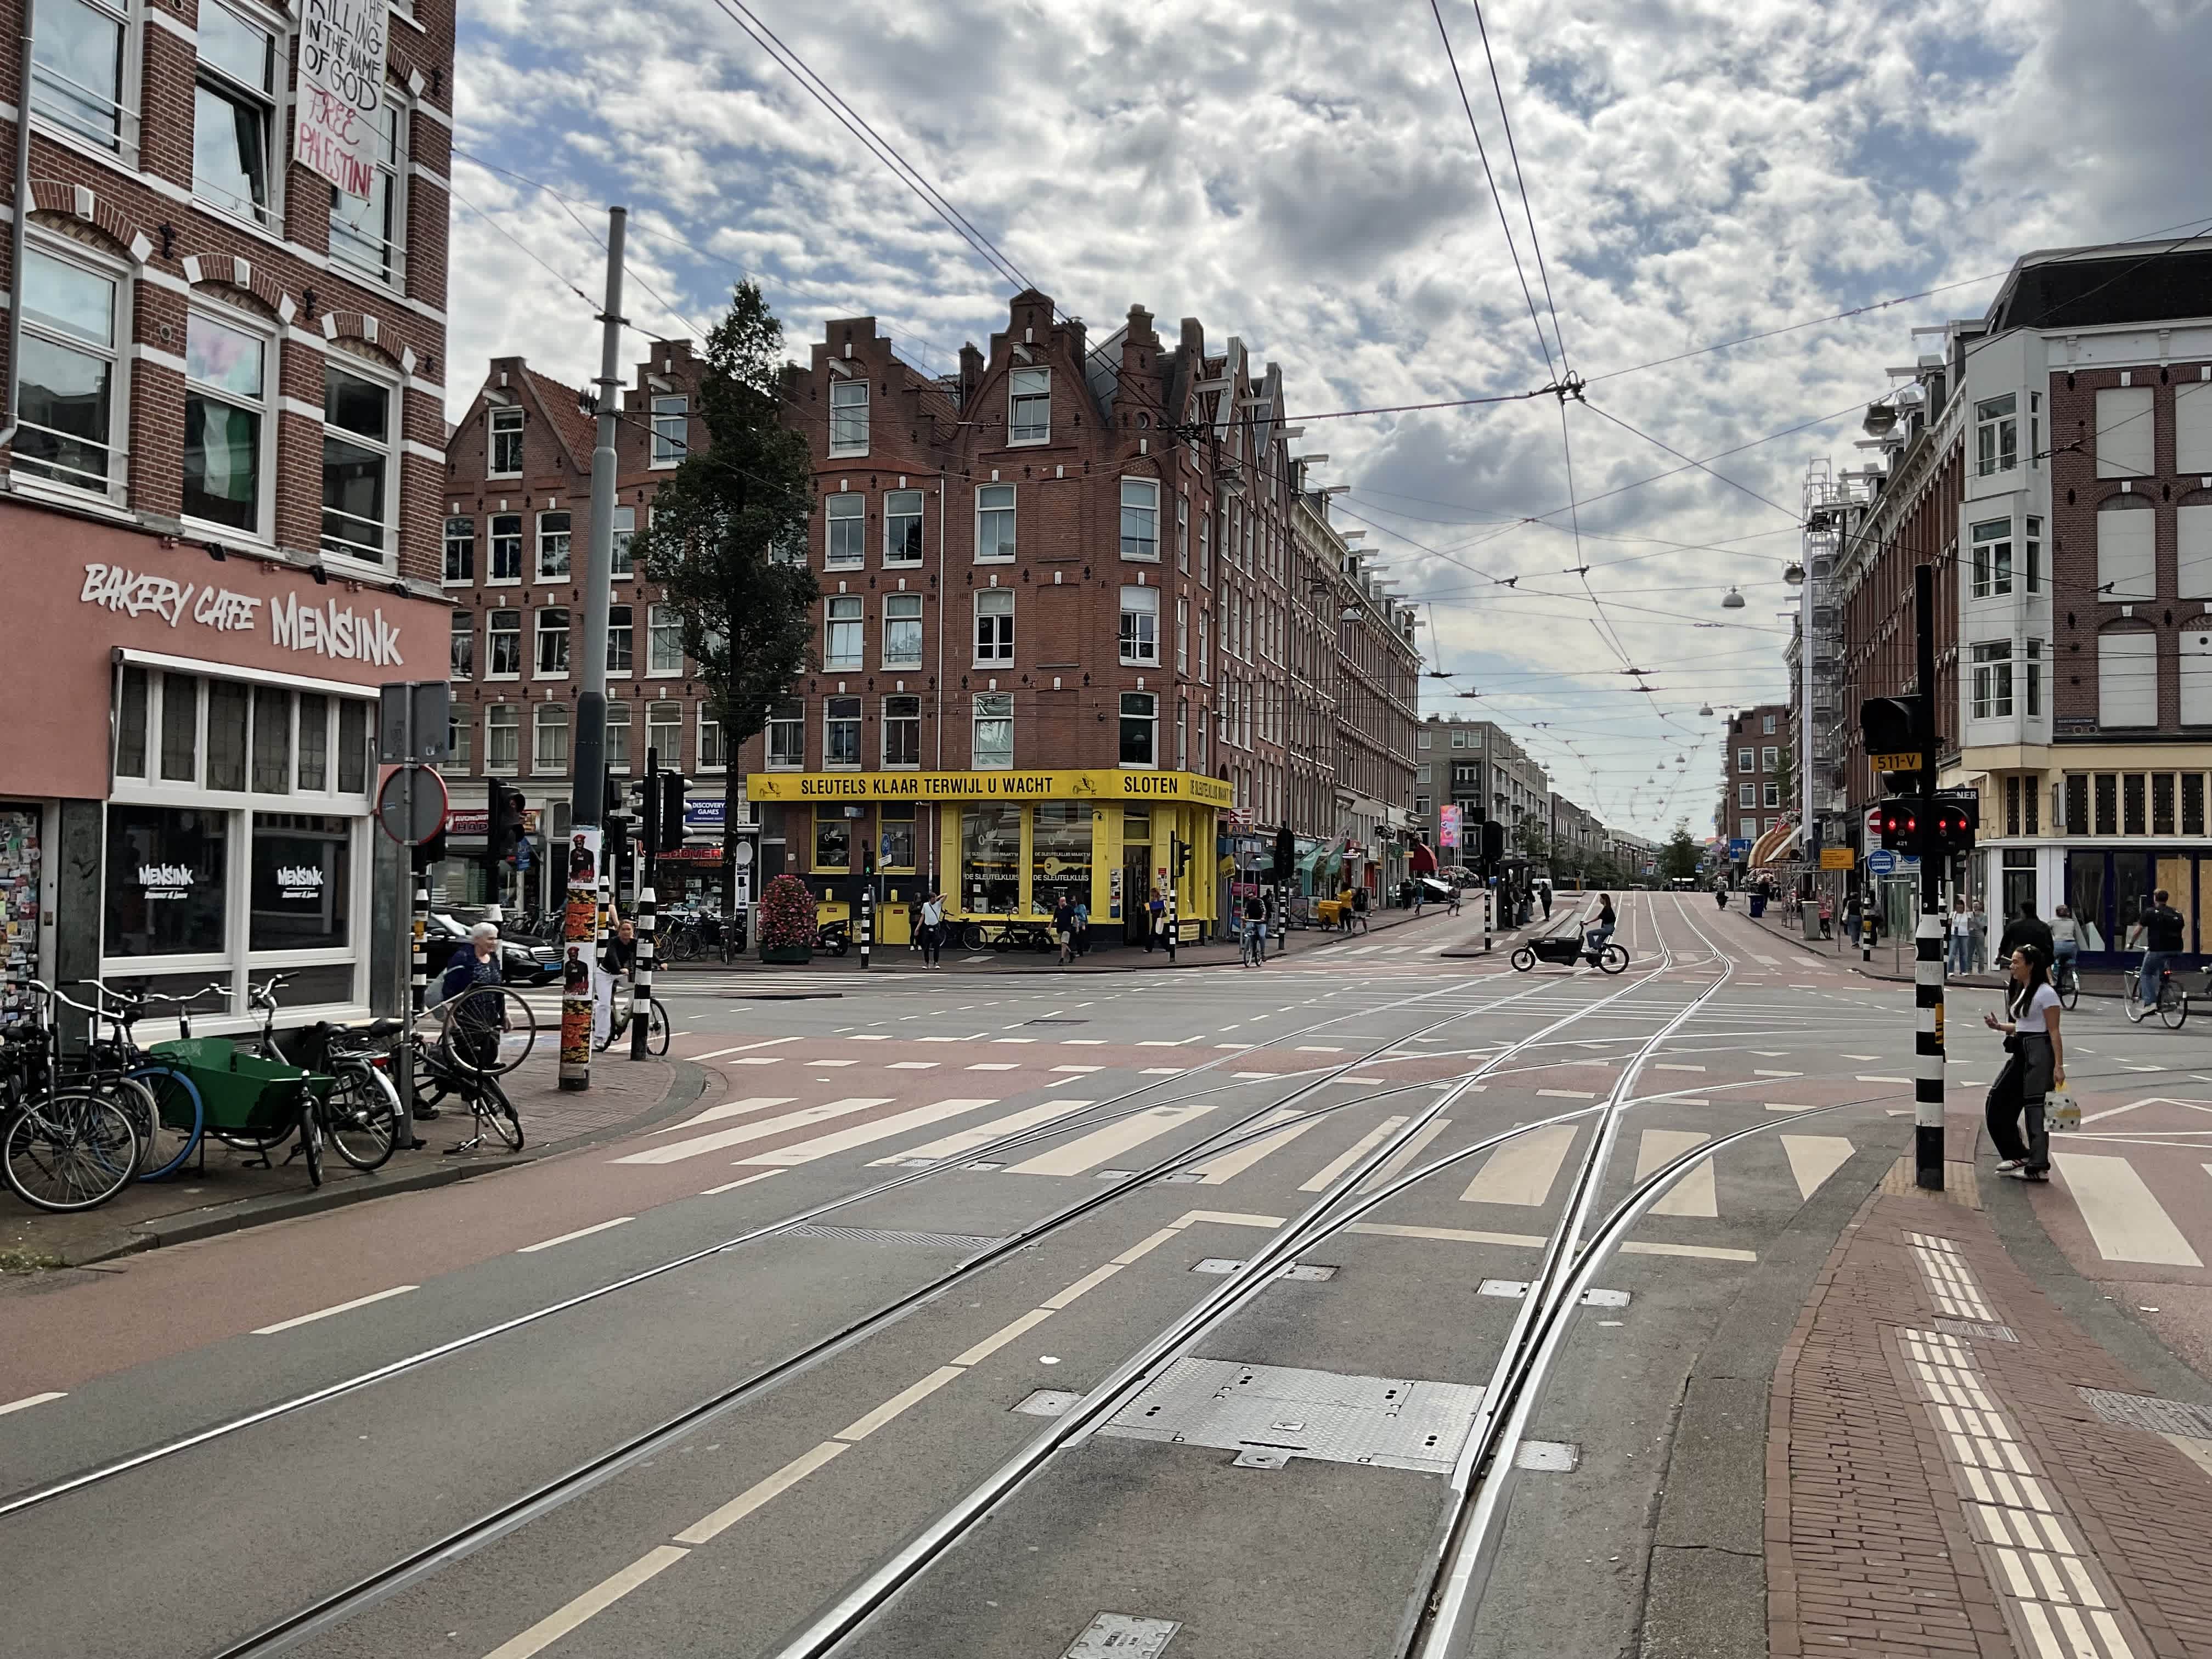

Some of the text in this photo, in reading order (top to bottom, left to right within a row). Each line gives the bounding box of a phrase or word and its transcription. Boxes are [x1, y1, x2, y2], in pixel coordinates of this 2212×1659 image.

[306, 17, 381, 88] IN THE NAME
[305, 44, 377, 110] OF GOD
[305, 83, 360, 145] FREE
[81, 563, 404, 667] BAKERY CAFE MENSINK
[1878, 755, 1916, 769] 511-V
[802, 777, 1053, 794] SLEUTELS KLAAR TERWIJL U WACHT
[1124, 776, 1178, 793] SLOTEN
[1233, 825, 1250, 833] ATM
[139, 863, 194, 885] MENSINK
[277, 865, 323, 886] MENSINK
